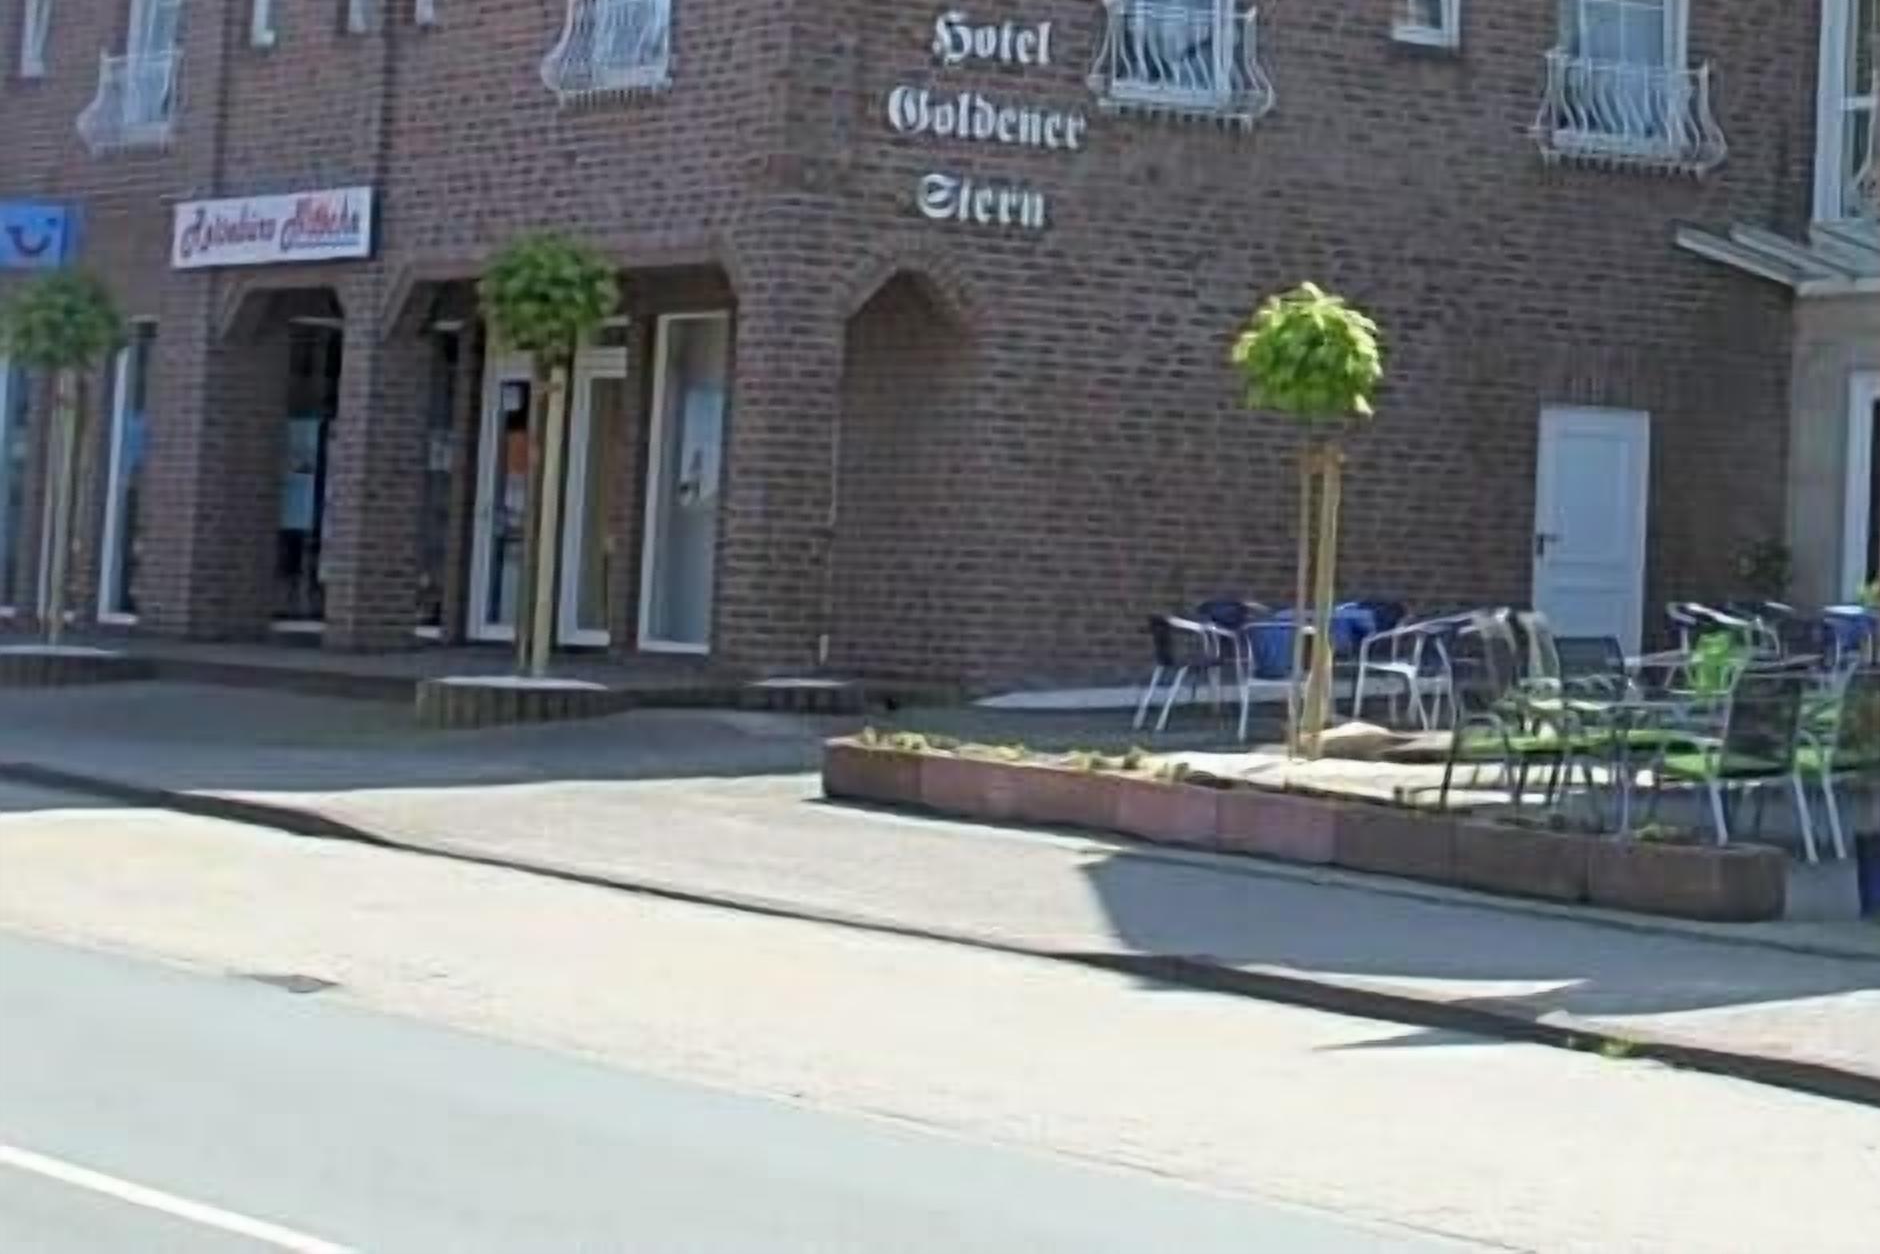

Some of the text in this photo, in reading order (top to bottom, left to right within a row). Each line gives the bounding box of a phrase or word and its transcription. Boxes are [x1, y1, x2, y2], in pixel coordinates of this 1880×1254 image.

[932, 10, 1052, 69] Hotel
[888, 85, 1087, 148] Goldener
[917, 173, 1044, 228] Stern
